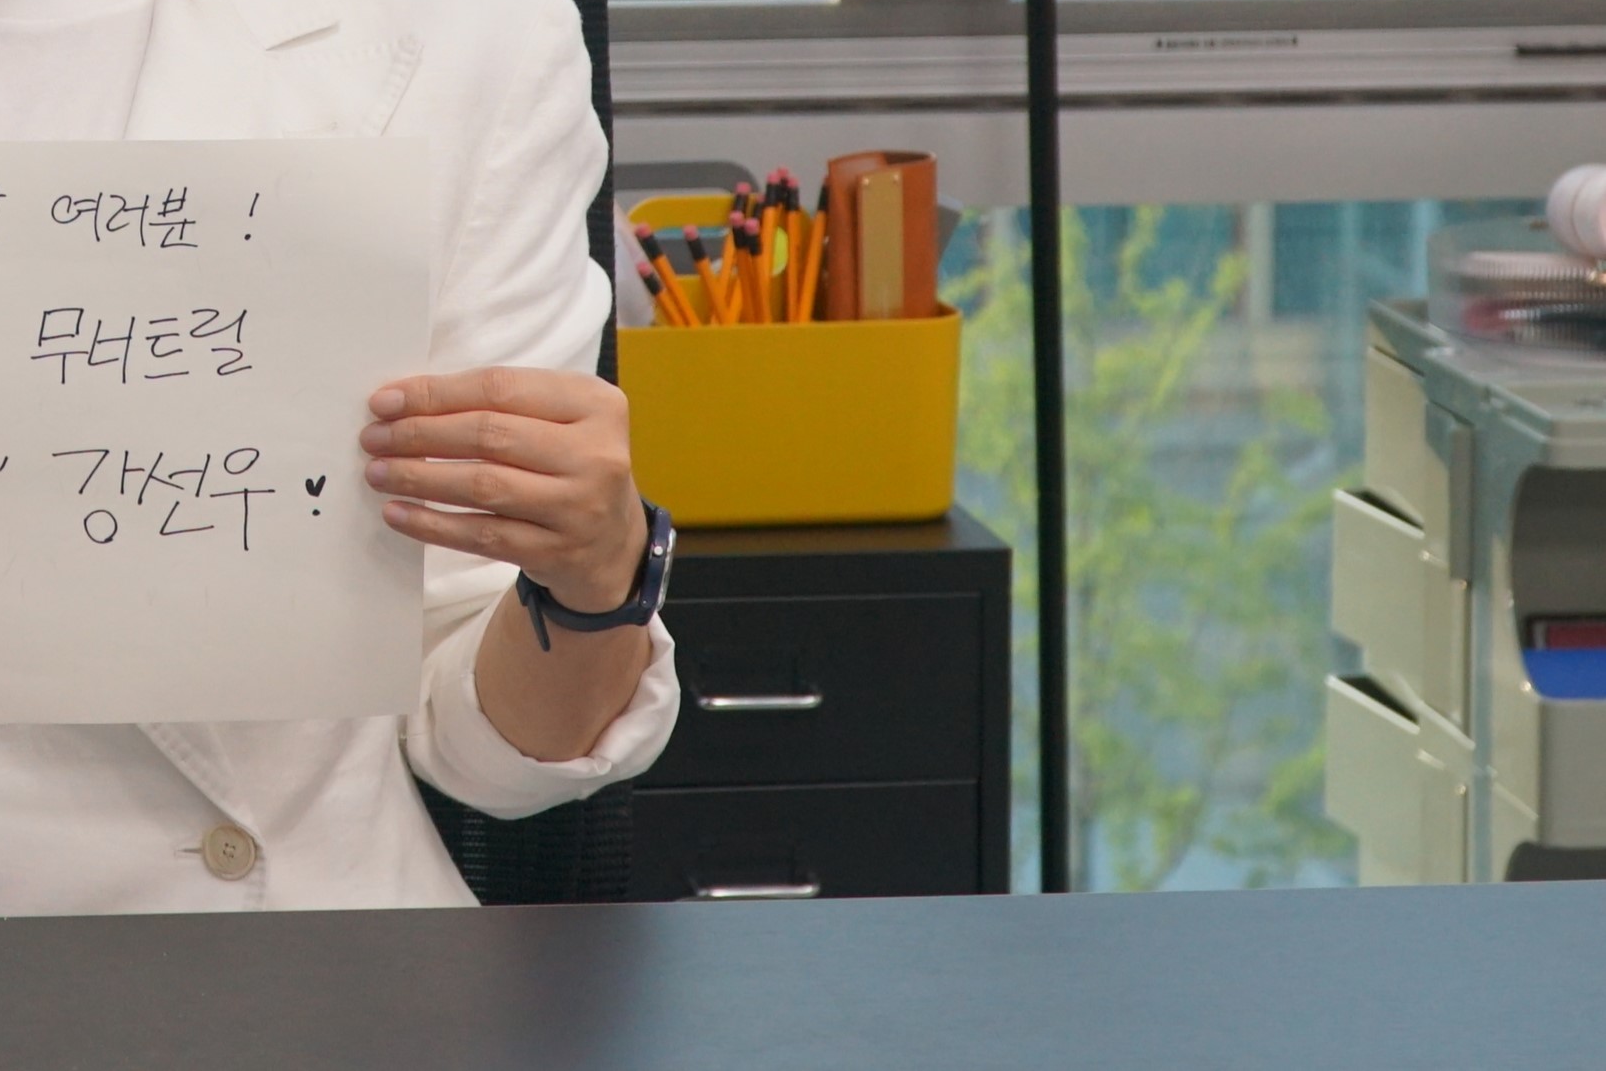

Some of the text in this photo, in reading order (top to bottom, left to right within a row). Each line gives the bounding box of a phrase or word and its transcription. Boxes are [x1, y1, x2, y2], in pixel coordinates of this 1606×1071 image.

[50, 186, 198, 249] 여러분
[30, 307, 254, 386] 무너트릴
[51, 447, 276, 552] 강선우
